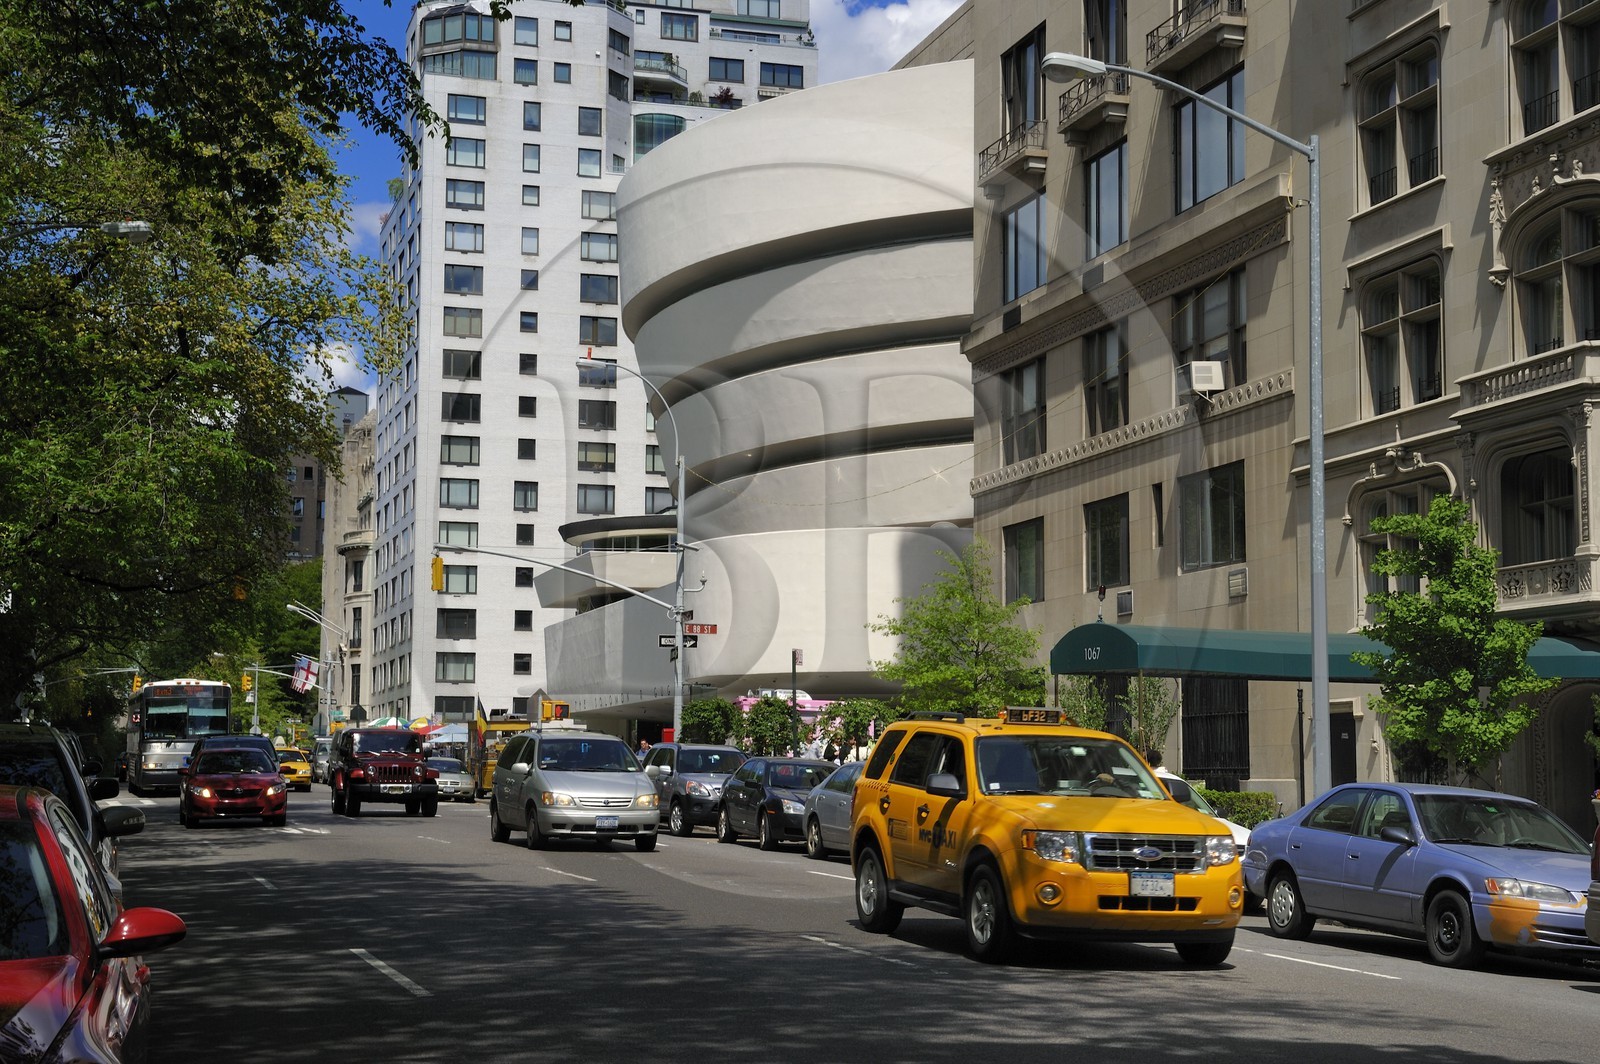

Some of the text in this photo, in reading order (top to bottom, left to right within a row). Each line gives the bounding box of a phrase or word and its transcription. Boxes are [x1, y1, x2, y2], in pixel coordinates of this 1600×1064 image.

[685, 625, 712, 634] E 88 ST
[1084, 647, 1101, 660] 1067
